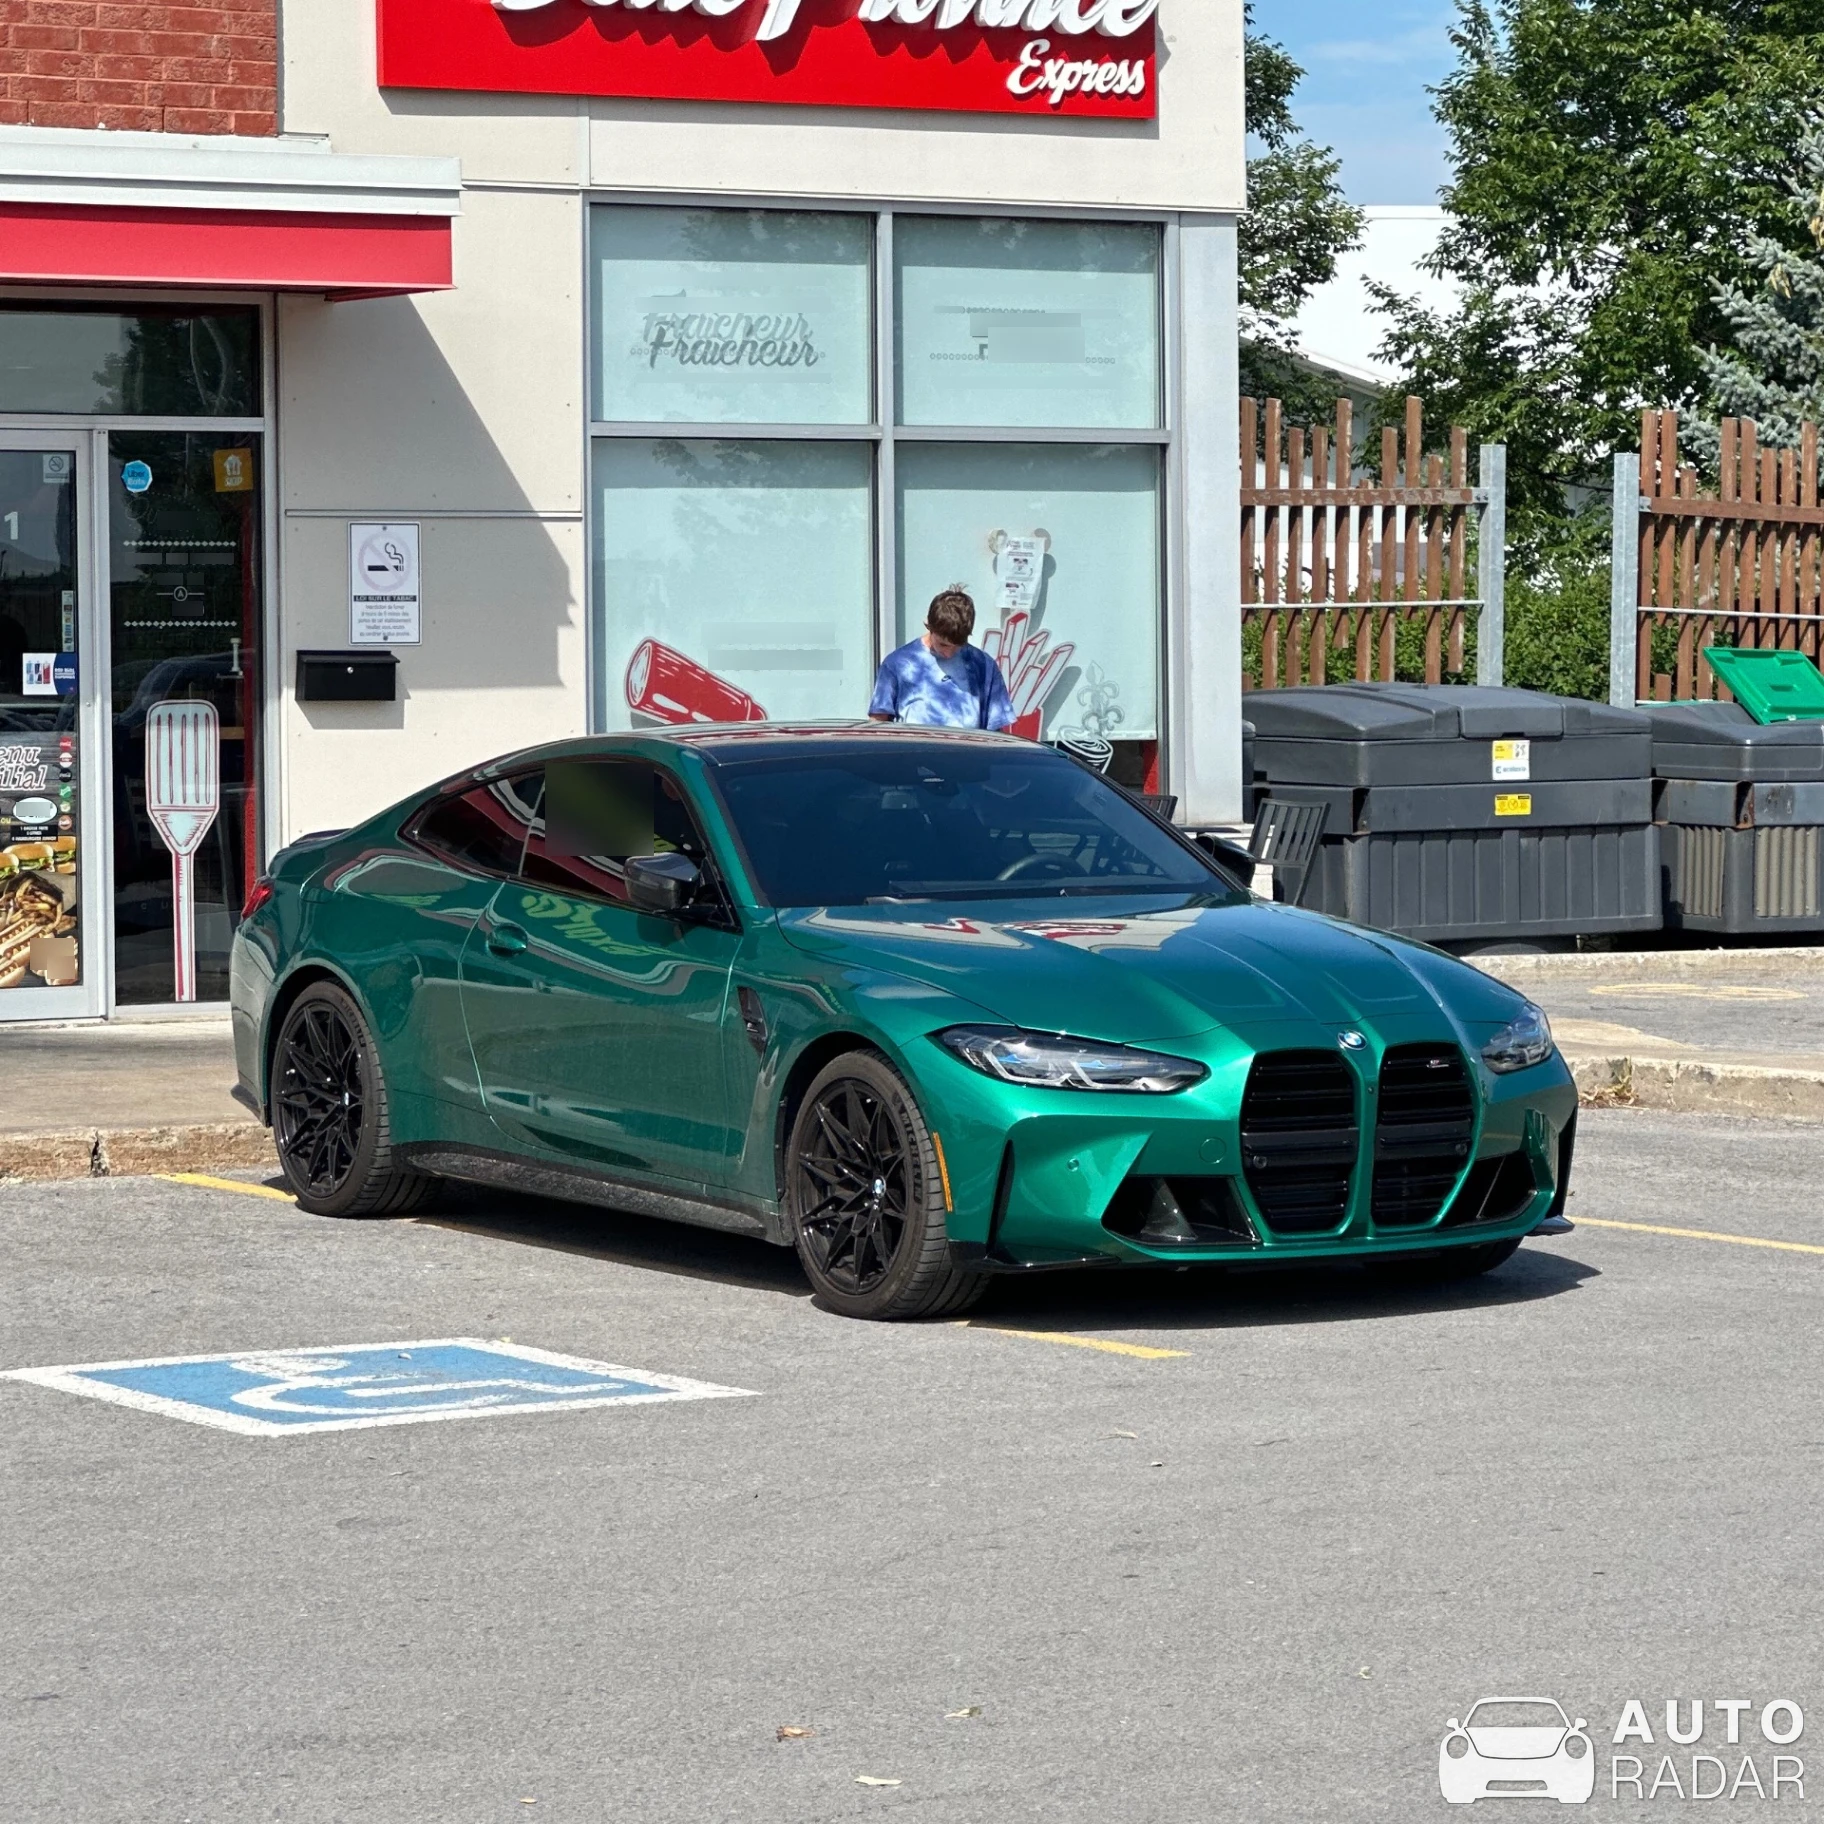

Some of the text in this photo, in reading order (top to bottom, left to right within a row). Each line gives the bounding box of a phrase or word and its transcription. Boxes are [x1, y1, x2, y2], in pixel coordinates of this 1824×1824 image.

[1005, 39, 1146, 105] Express
[127, 470, 146, 478] Uber
[4, 511, 18, 540] 1
